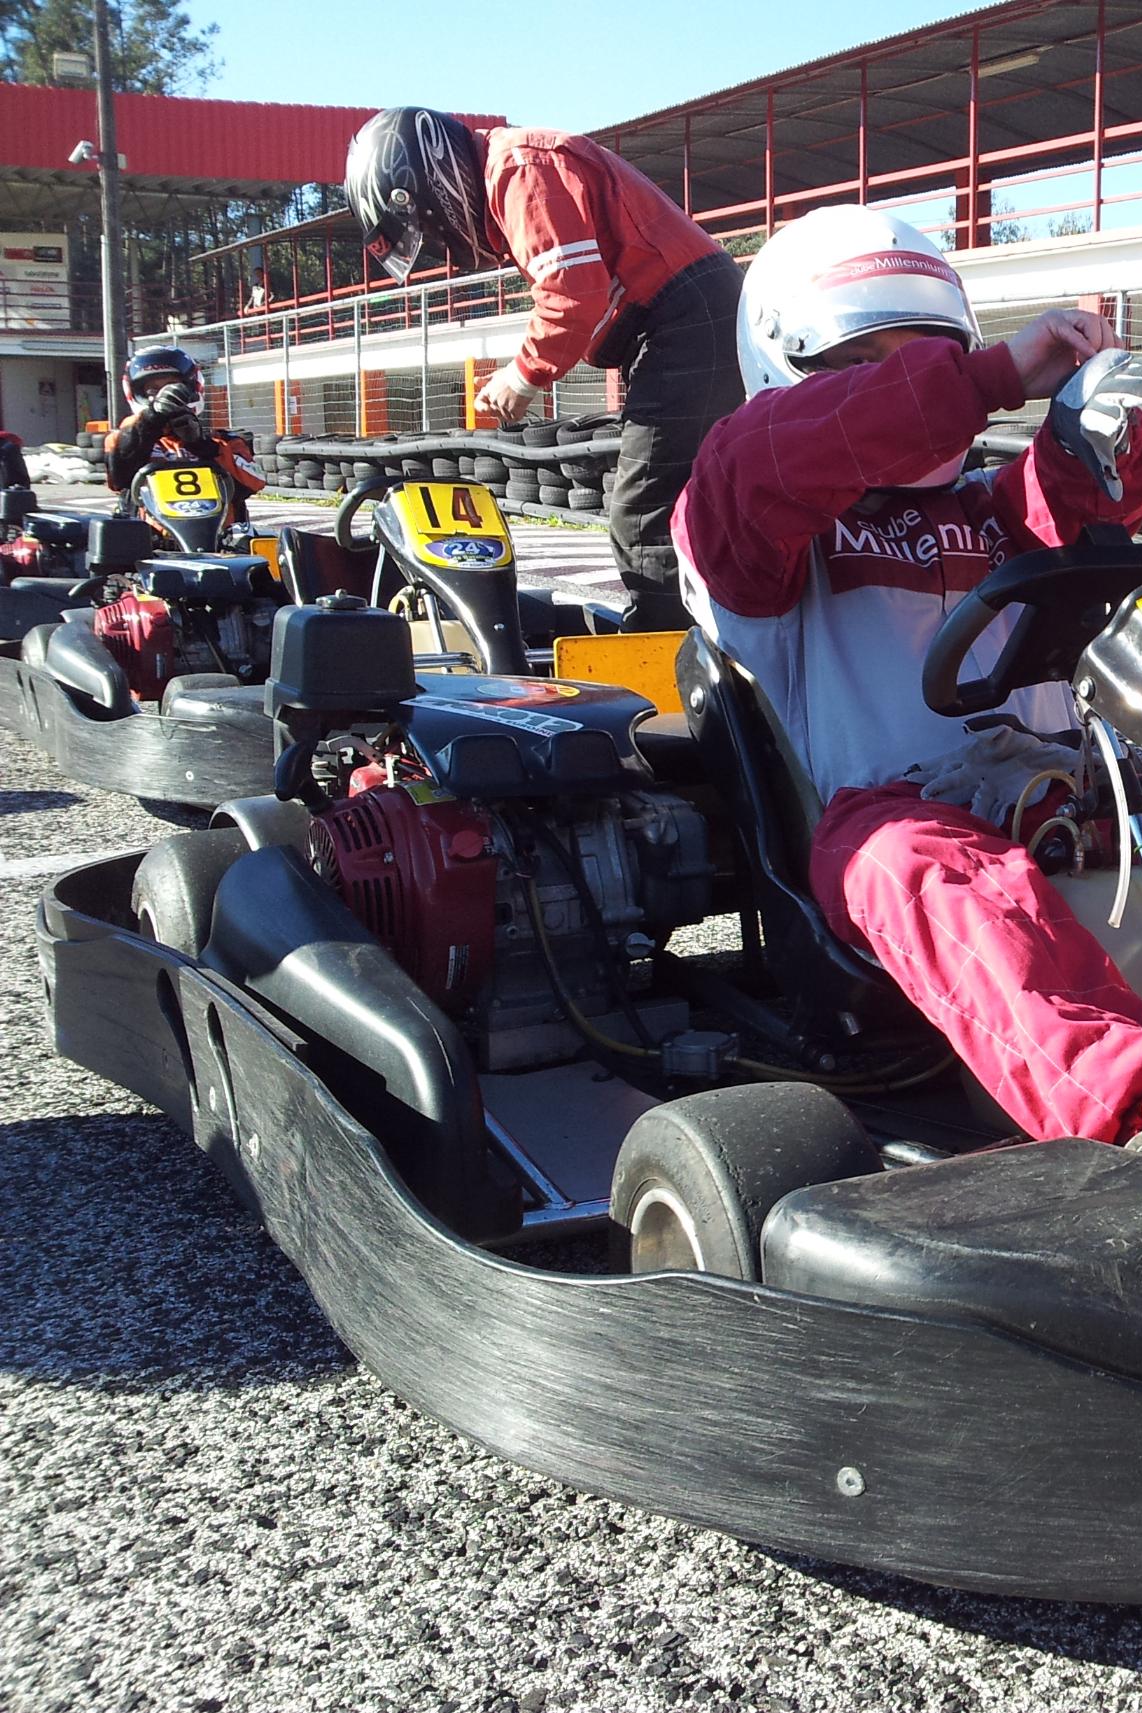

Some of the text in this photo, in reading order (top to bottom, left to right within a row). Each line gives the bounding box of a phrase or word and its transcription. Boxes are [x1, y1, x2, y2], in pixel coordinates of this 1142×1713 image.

[874, 257, 948, 276] Millennium
[173, 470, 202, 496] 8
[418, 486, 483, 529] 14
[857, 509, 922, 539] clube
[448, 542, 481, 556] 24
